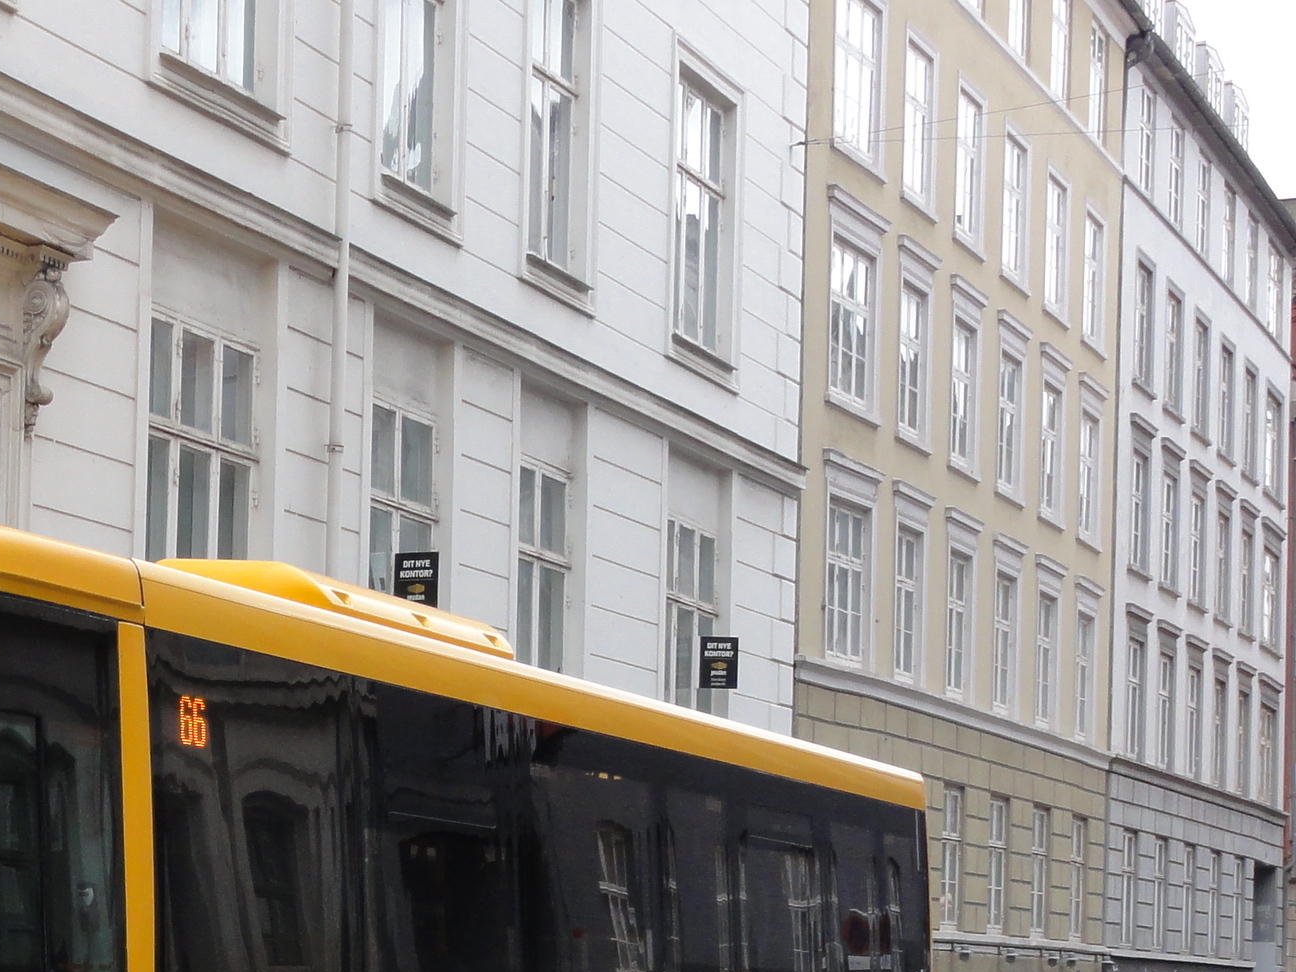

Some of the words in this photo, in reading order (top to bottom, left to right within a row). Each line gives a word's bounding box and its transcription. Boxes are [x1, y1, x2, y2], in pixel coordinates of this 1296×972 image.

[402, 560, 415, 568] DIT
[415, 559, 431, 568] NYE
[399, 569, 433, 578] KONTOR?
[179, 695, 206, 748] 66
